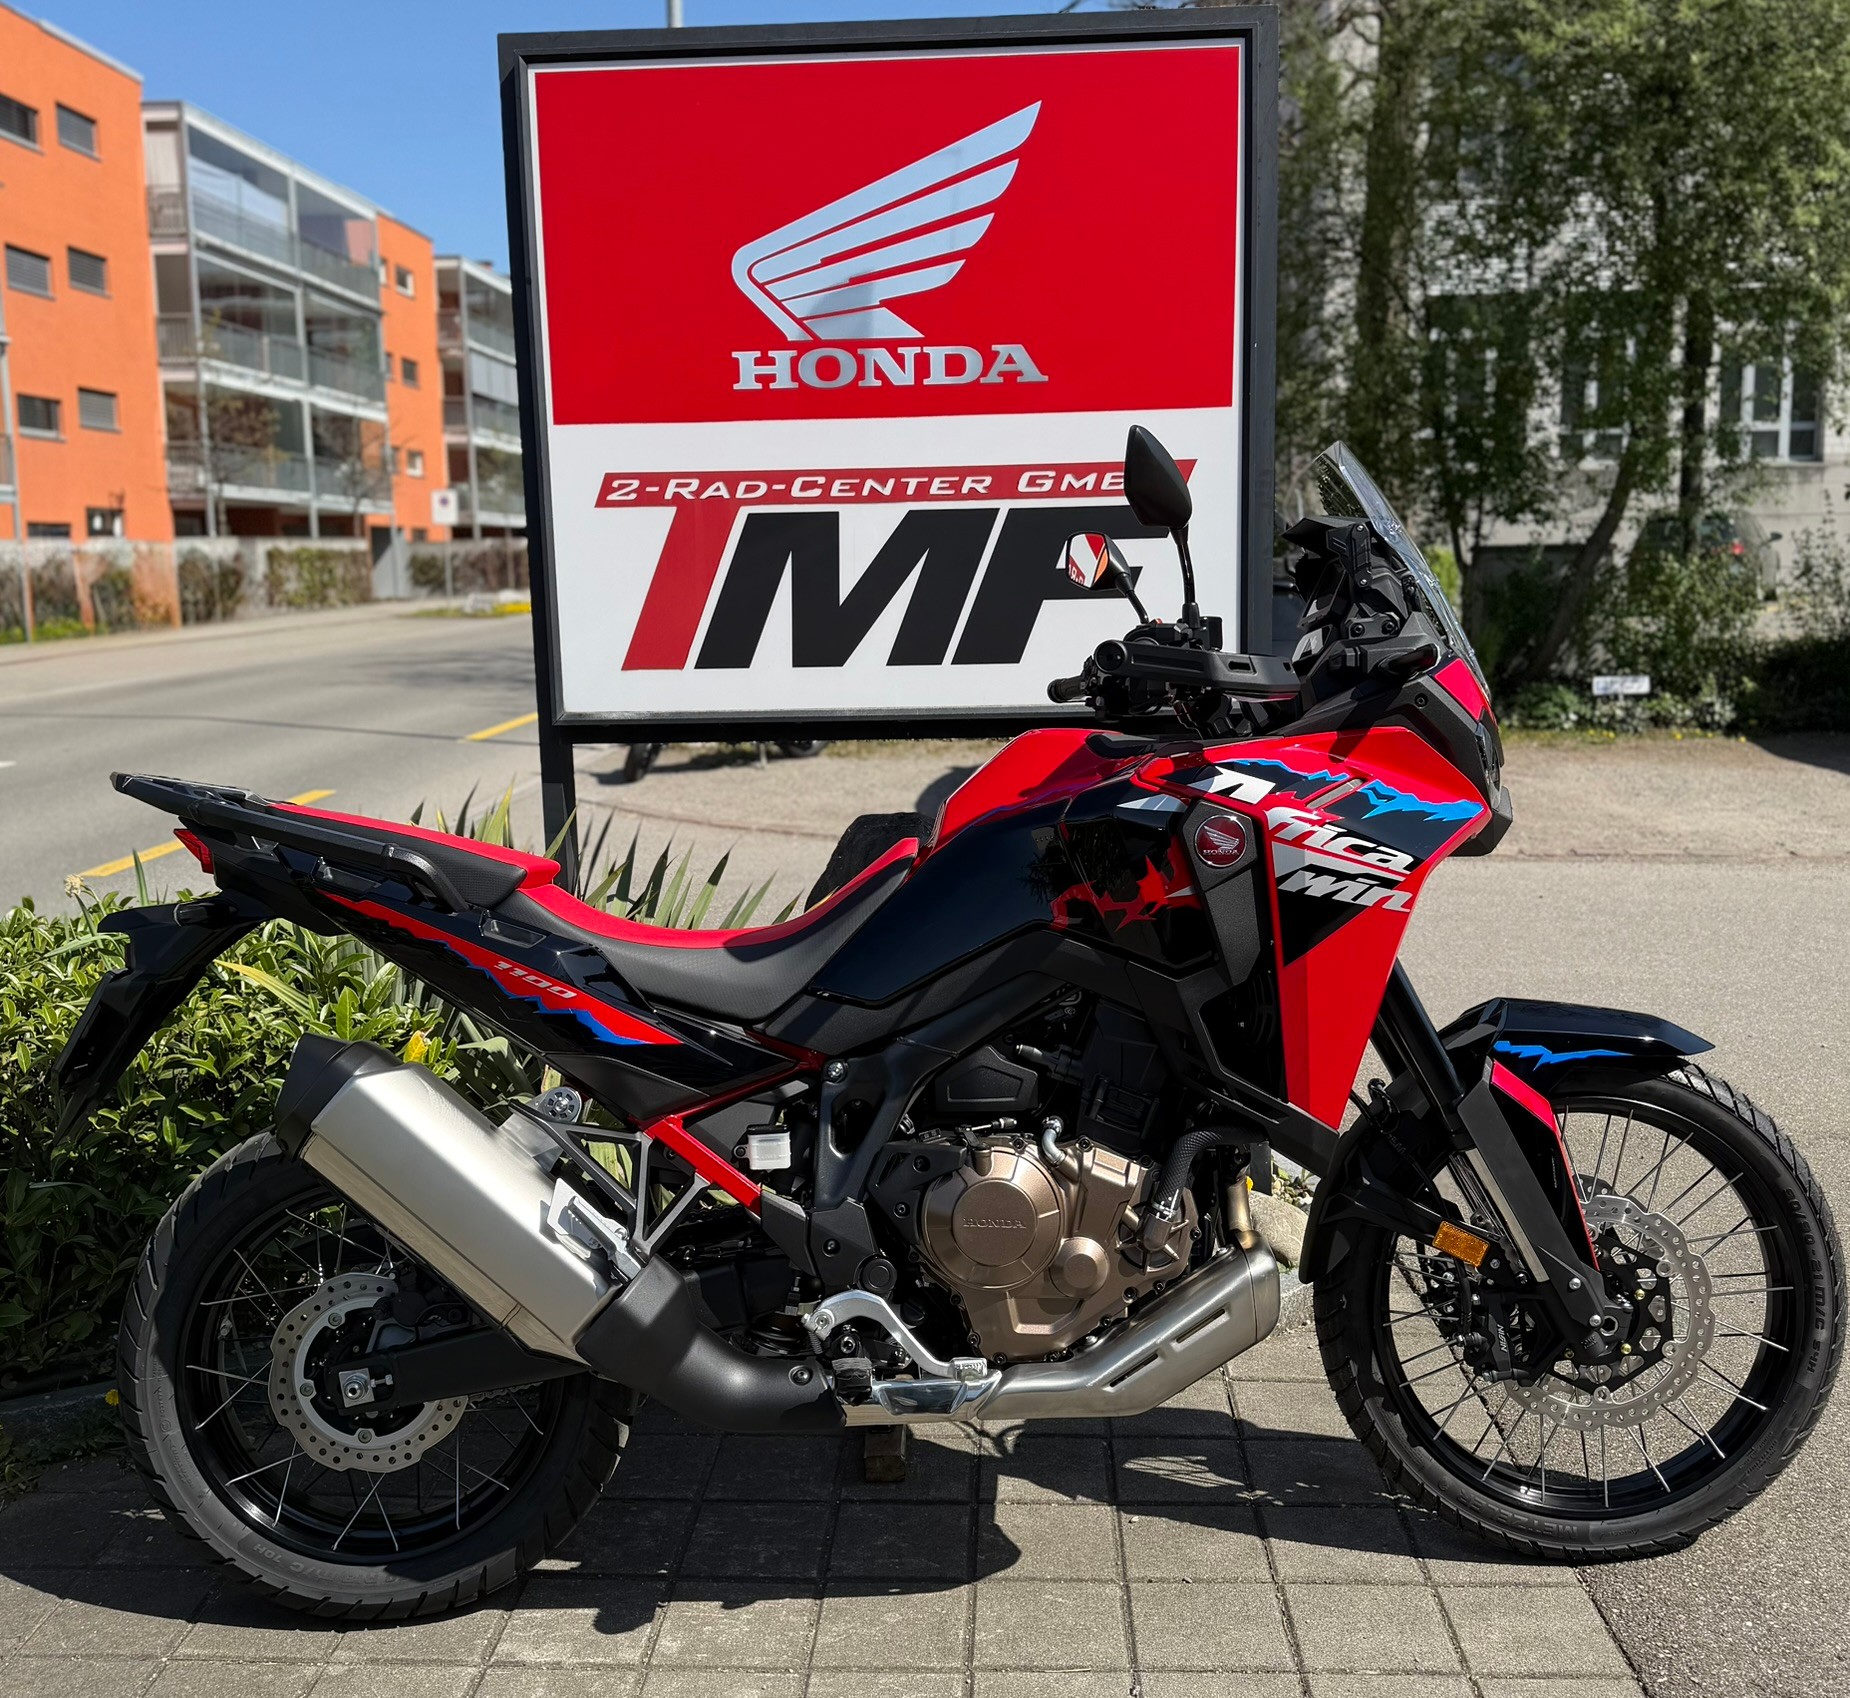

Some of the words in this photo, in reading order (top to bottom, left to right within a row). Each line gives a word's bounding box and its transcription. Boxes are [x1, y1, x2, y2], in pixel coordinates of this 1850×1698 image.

[732, 345, 1049, 390] HONDA
[494, 961, 578, 999] 1100
[963, 1218, 1027, 1229] HONDA
